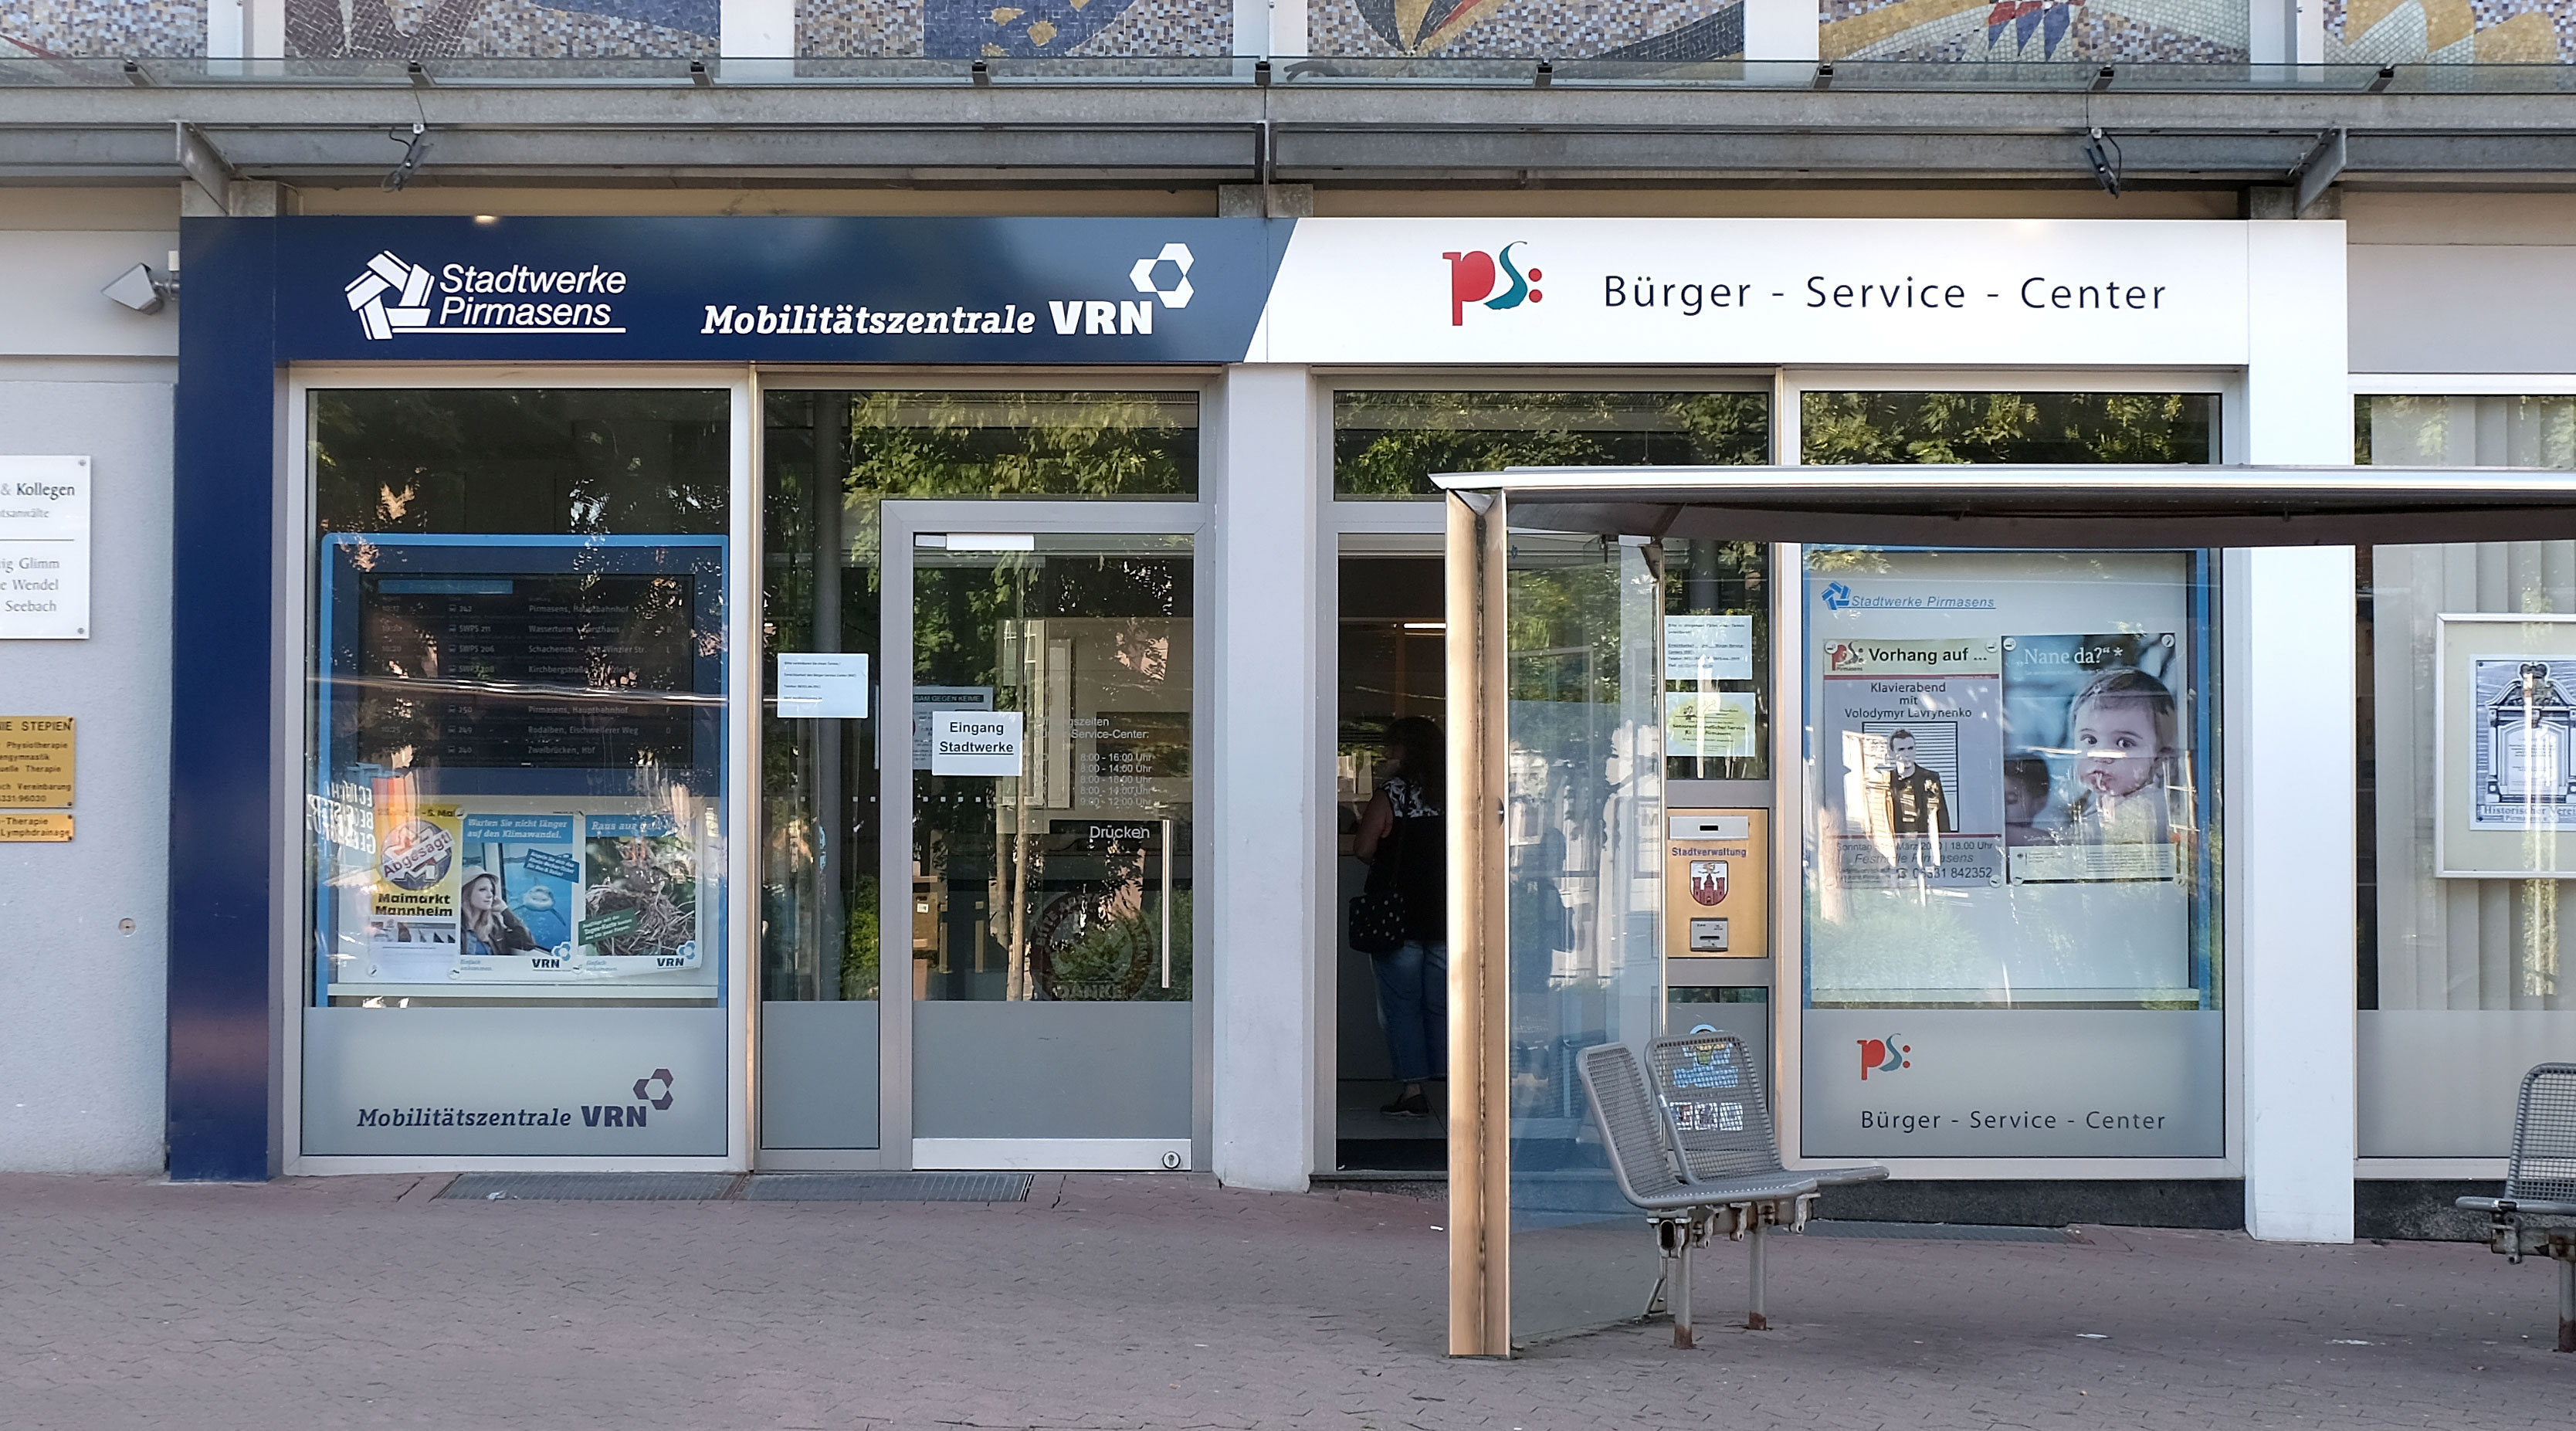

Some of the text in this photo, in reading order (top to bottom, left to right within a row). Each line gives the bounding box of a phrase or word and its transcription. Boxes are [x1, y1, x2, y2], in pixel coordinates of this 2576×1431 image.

[439, 264, 626, 293] Stadtwerke
[1604, 273, 1751, 317] Bürger
[1806, 274, 1967, 310] Service
[2020, 276, 2166, 310] Center
[439, 297, 611, 326] Pirmasens
[700, 300, 1154, 335] Mobilitätszentrale VRN
[16, 482, 75, 500] Kollegen
[19, 558, 60, 569] Glimm
[12, 578, 59, 590] Wendel
[5, 599, 57, 612] Seebach
[1851, 595, 1995, 609] Stadtwerke Pirmasens
[1869, 648, 1937, 666] Vorhang
[1942, 647, 1970, 662] auf
[1870, 681, 1947, 693] Klavierabend
[1899, 695, 1919, 706] mit
[1844, 707, 1973, 721] Volodymyr Lavrynenko
[22, 721, 71, 731] STEPIEN
[949, 721, 1005, 736] Eingang
[6, 741, 69, 750] Physiotherapie
[939, 741, 1014, 753] Stadtwerke
[1135, 753, 1152, 761] Uhr
[25, 765, 62, 773] Therapie
[1135, 765, 1152, 773] Uhr
[1135, 775, 1152, 784] Uhr
[17, 782, 72, 792] Vereinbarung
[1135, 786, 1152, 795] Uhr
[468, 819, 568, 829] Warten Sie nicht länger
[1, 829, 70, 839] Lymphdrainage
[467, 829, 483, 839] auf
[483, 829, 500, 838] den
[1090, 824, 1151, 839] Drücken
[1671, 846, 1747, 858] Stadtverwaltung
[1951, 841, 1975, 851] 18.00
[1977, 841, 1993, 851] Uhr
[383, 832, 452, 878] Abgesagt!
[1950, 866, 1993, 879] 842352
[378, 894, 451, 904] Maimarkt
[375, 906, 452, 917] Mannheim
[531, 958, 561, 968] VRN
[656, 958, 685, 967] VRN
[357, 1105, 647, 1127] Mobilitätszentrale VRN
[1861, 1110, 1941, 1134] Bürger
[1970, 1111, 2057, 1129] Service
[2086, 1111, 2166, 1130] Center
